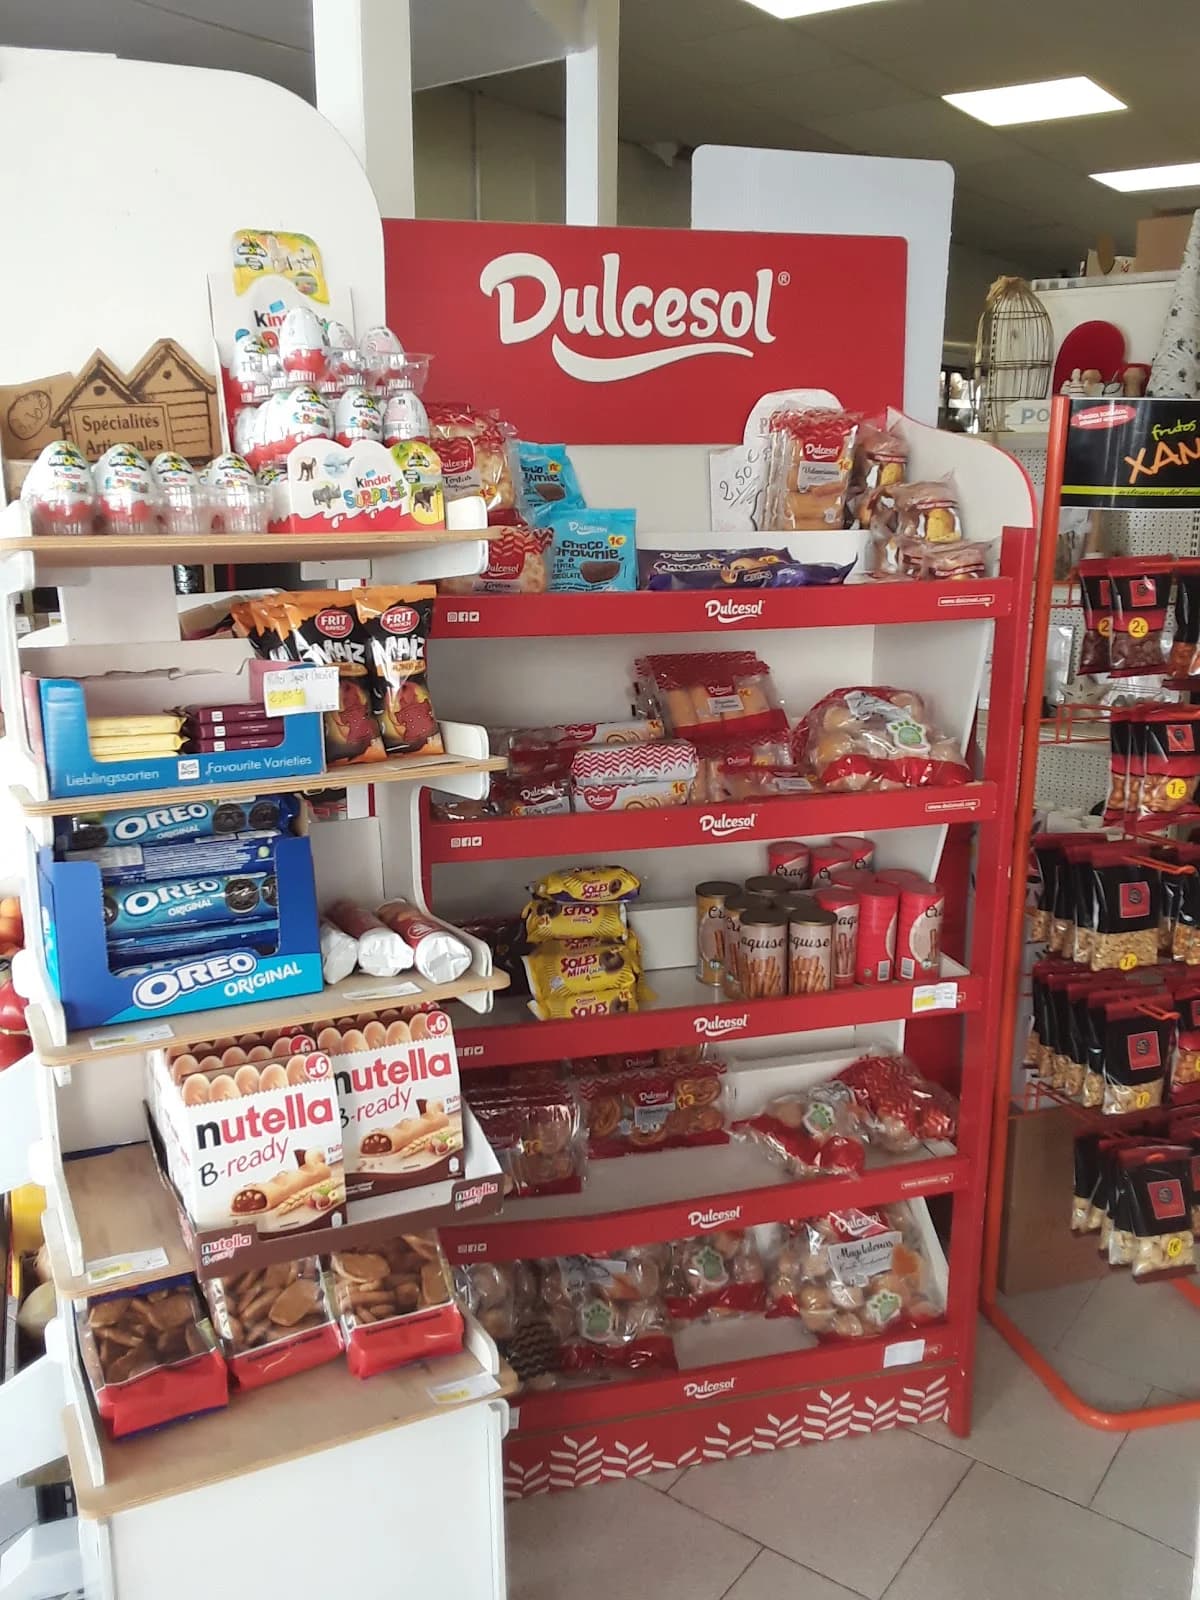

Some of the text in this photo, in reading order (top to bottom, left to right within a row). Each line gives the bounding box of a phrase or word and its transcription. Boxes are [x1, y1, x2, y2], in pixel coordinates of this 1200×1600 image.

[480, 252, 776, 344] Dulcesol
[82, 413, 159, 432] Spécialités
[1152, 419, 1196, 441] frutos
[805, 443, 839, 456] Dulcesol
[343, 480, 407, 509] SURPRISE
[705, 598, 763, 617] Dulcesol
[320, 615, 347, 626] FRIT
[386, 611, 413, 625] FRIT
[1132, 620, 1146, 634] 2€
[205, 755, 312, 775] Favourite Varieties
[66, 769, 159, 786] Lieblingssorten
[1170, 781, 1185, 795] 1€
[115, 803, 208, 840] OREO
[700, 813, 755, 832] Dulcesol
[156, 825, 200, 839] ORIGINAL
[125, 879, 219, 916] OREO
[582, 882, 608, 897] SOLES
[168, 899, 213, 917] ORIGINAL
[561, 954, 598, 973] SOLES
[568, 965, 590, 978] MINI
[138, 953, 253, 1005] OREO
[224, 961, 302, 997] ORIGINAL
[428, 1015, 447, 1033] x6
[694, 1014, 748, 1033] Dulcesol
[308, 1056, 328, 1076] x6
[334, 1048, 452, 1095] nutella
[196, 1093, 333, 1150] nutella
[198, 1136, 289, 1187] B-ready
[456, 1182, 498, 1202] nutella
[688, 1205, 741, 1225] Dulcesol
[202, 1233, 252, 1254] nutella
[684, 1377, 736, 1397] Dulcesol
